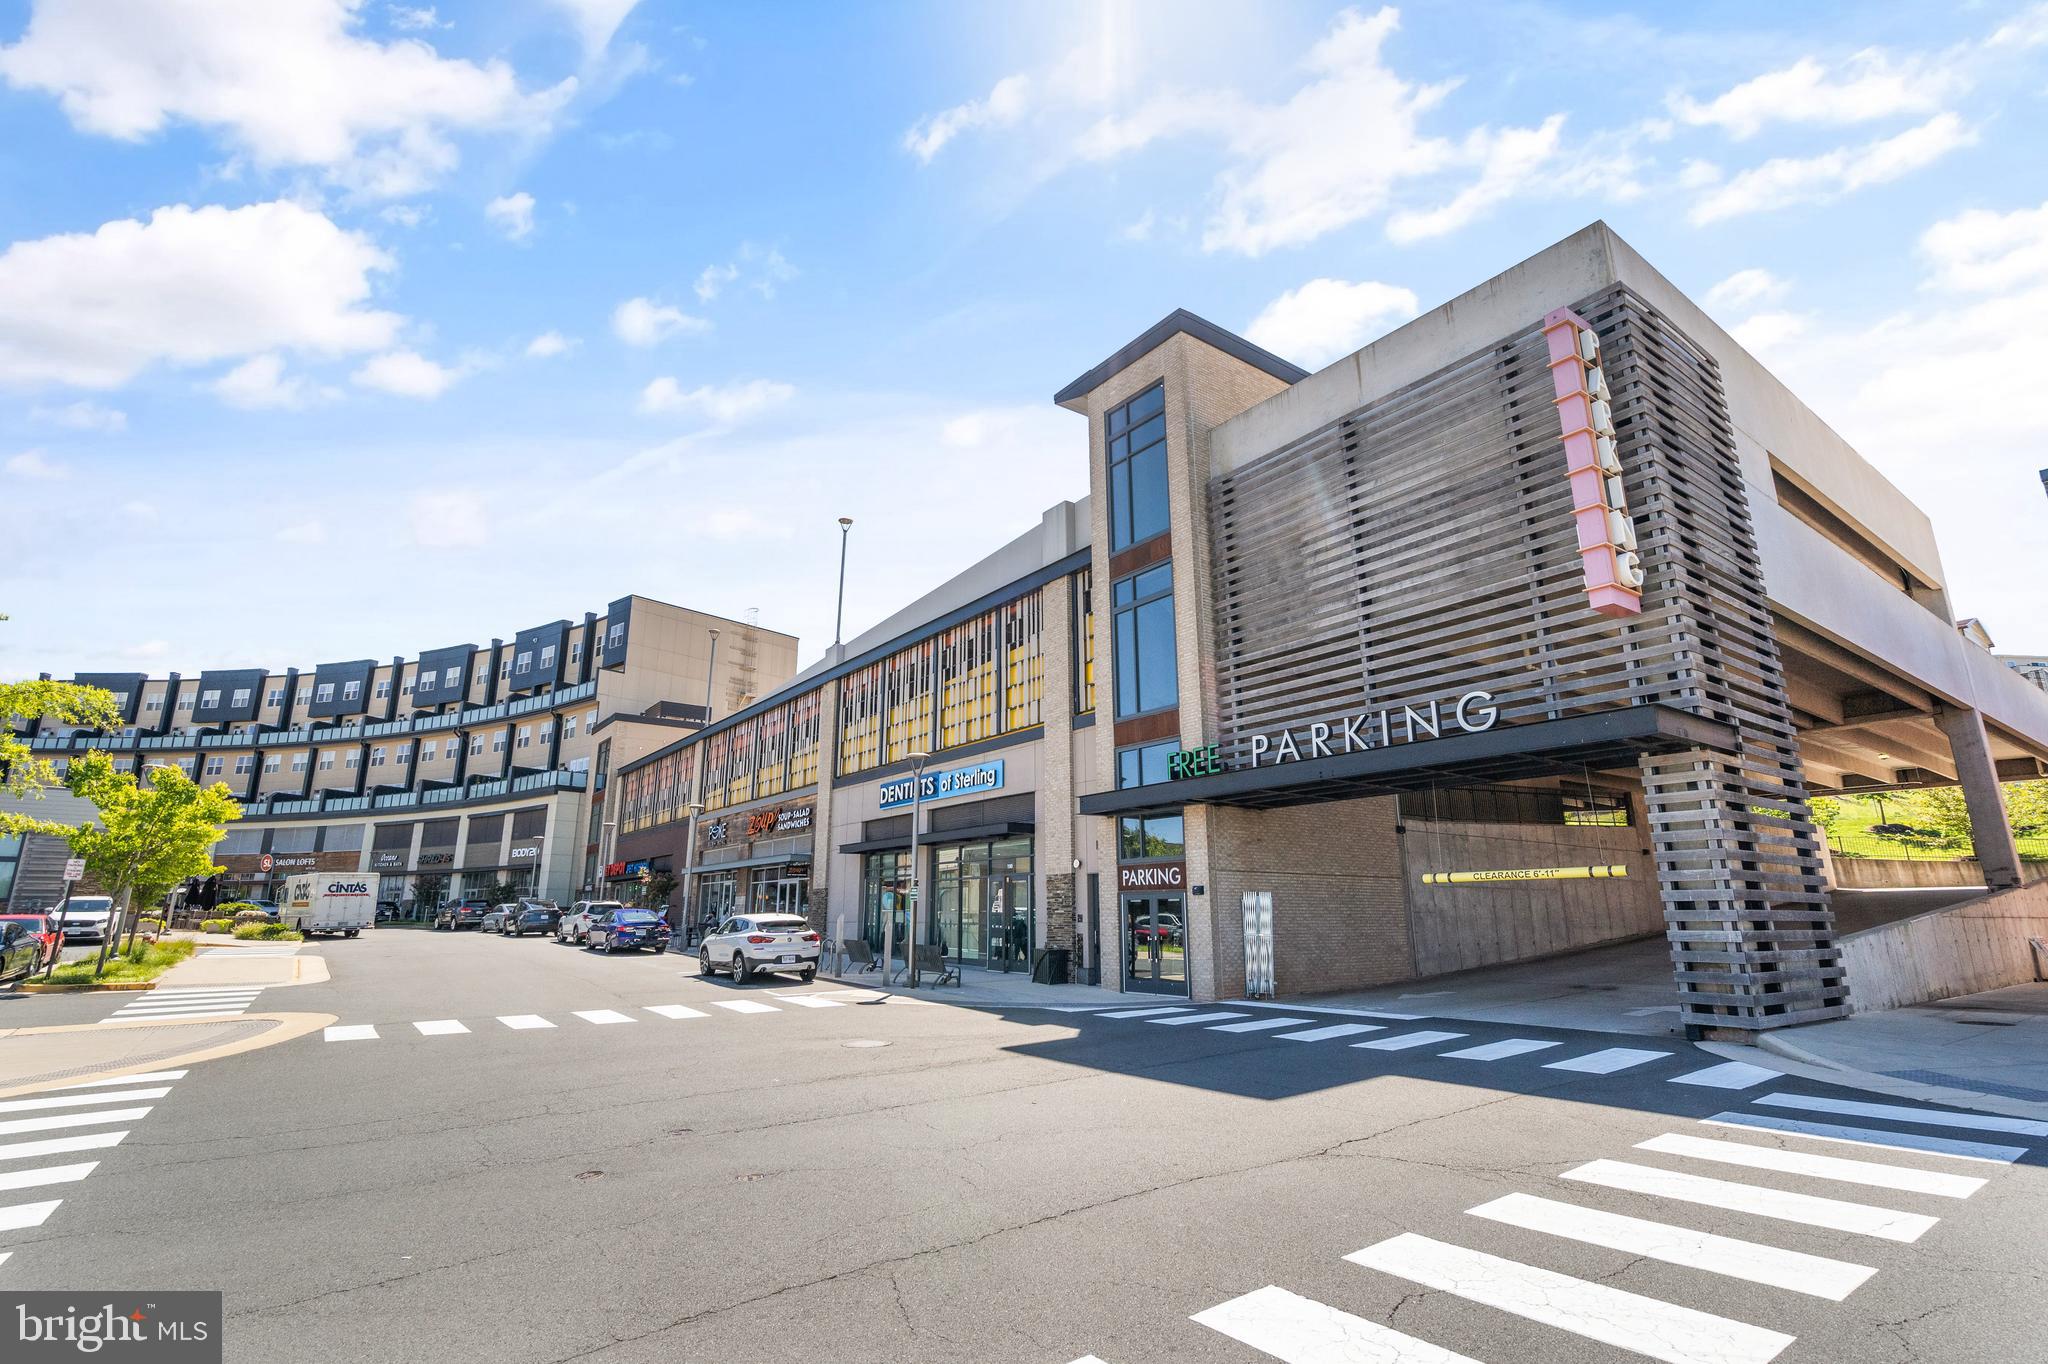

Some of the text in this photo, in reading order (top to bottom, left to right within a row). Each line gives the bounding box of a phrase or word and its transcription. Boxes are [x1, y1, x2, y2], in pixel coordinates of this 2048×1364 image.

[1579, 327, 1644, 588] PARKING
[1167, 691, 1502, 779] FREE PARKING
[880, 768, 995, 804] DENTITS of Sterling
[777, 817, 810, 831] SANDWICHES
[275, 858, 316, 866] SALON LOFTS
[1122, 867, 1181, 886] PARKING
[1473, 870, 1531, 881] CLEARANCE
[328, 881, 367, 893] CINTAS
